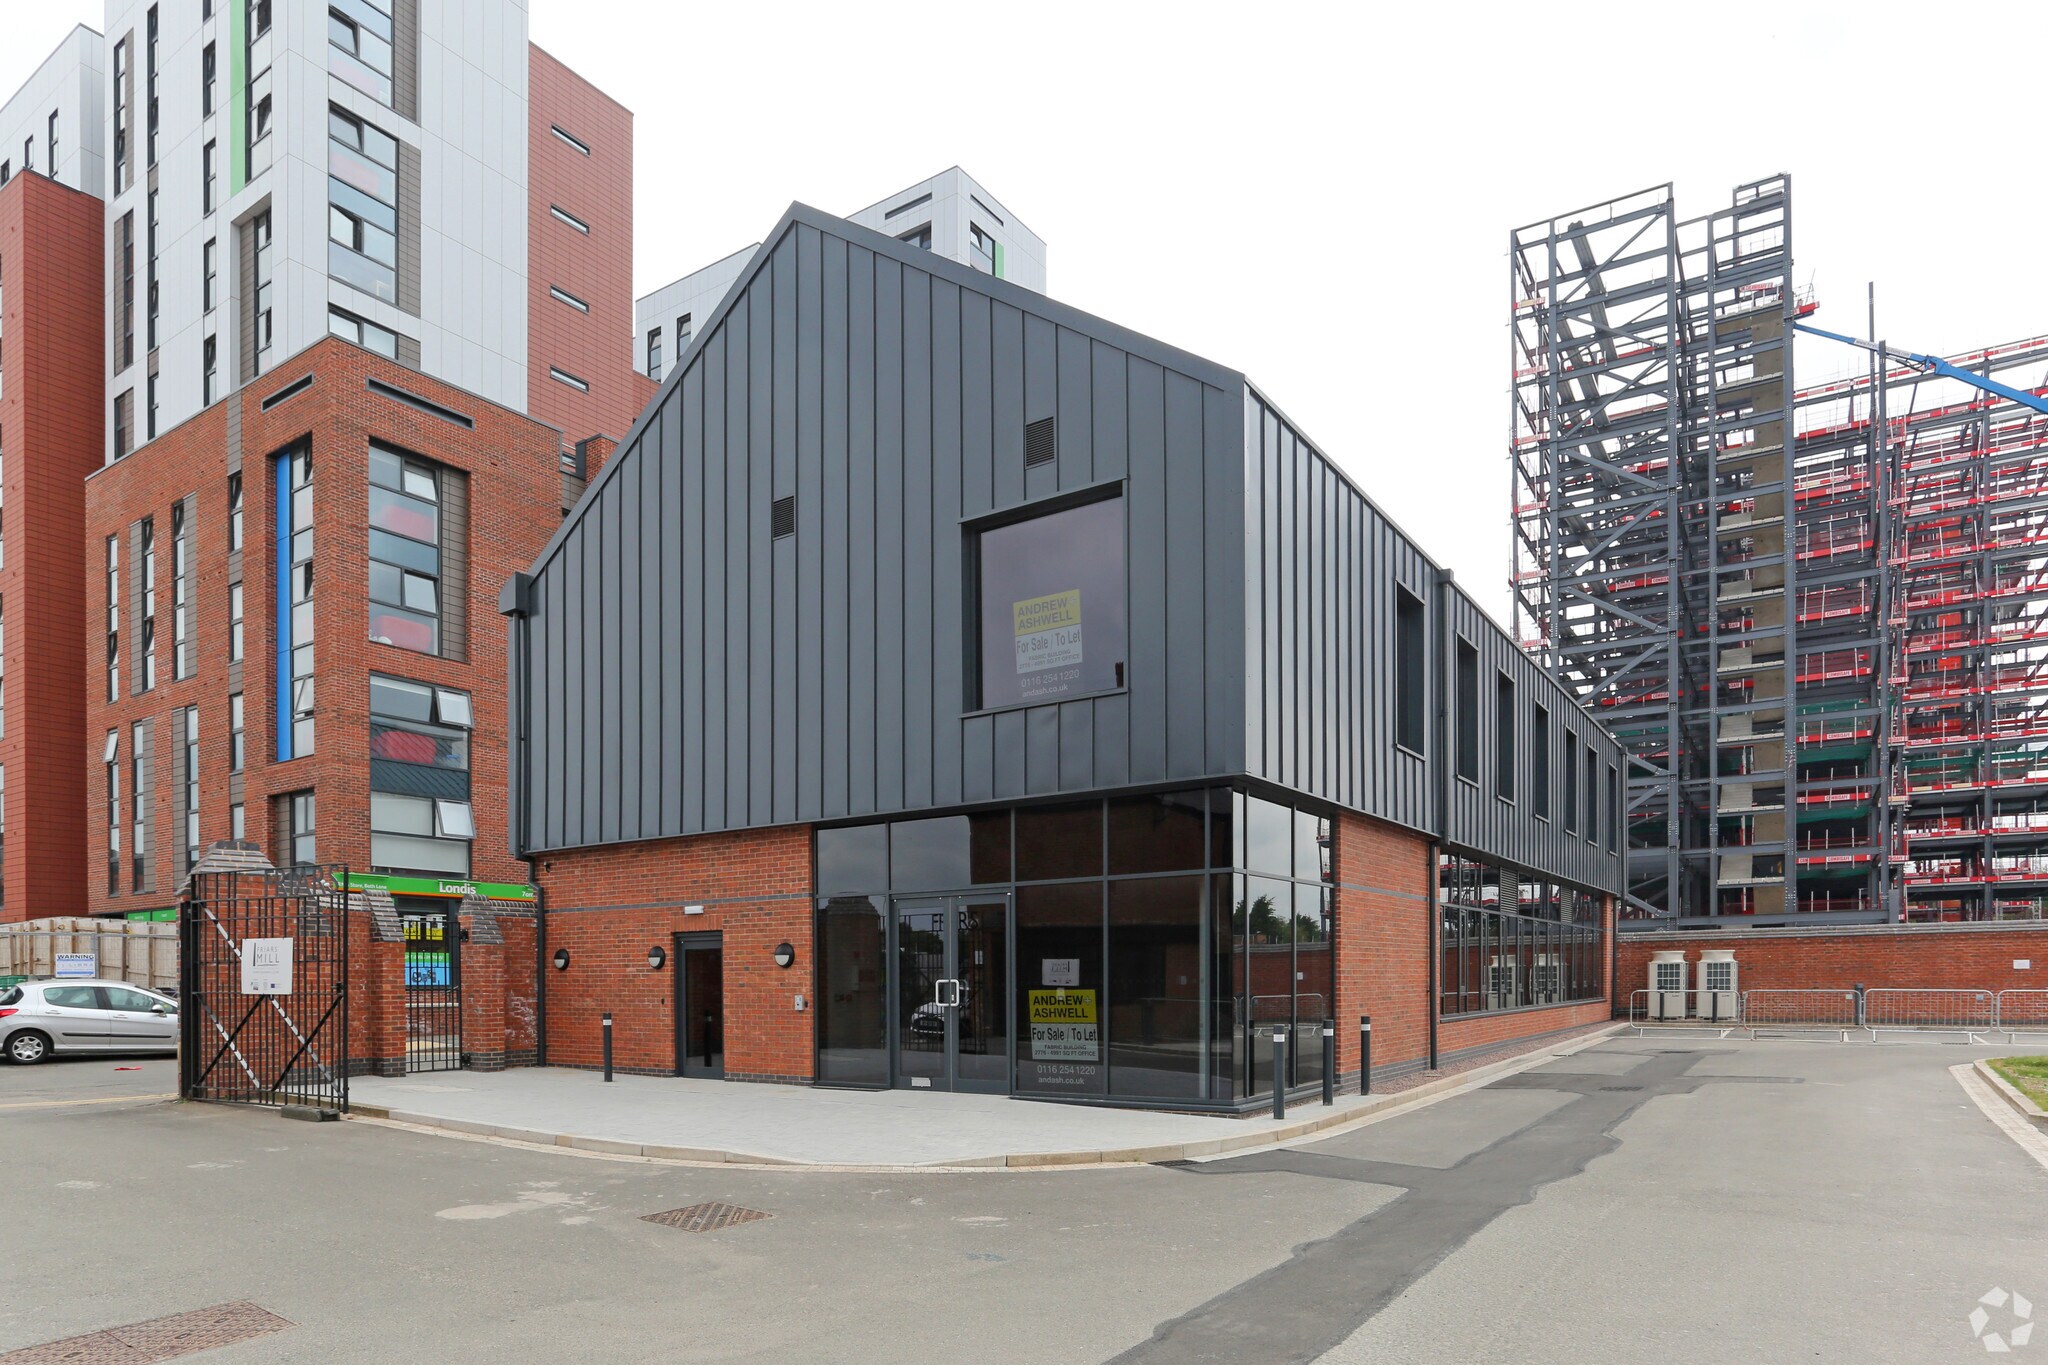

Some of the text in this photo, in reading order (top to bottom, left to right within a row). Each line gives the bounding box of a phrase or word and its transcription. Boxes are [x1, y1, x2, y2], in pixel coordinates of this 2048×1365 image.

[1018, 597, 1068, 618] ANDREW
[1018, 610, 1073, 630] ASHWELL
[1016, 640, 1029, 654] For
[1031, 636, 1048, 651] Sale
[1055, 632, 1065, 646] To
[1067, 629, 1080, 644] Let
[1047, 649, 1071, 658] BUILDING
[1061, 653, 1080, 661] OFFICE
[1021, 669, 1080, 687] 0116 254 1220
[1022, 683, 1068, 697] andash.co.uk
[439, 881, 477, 894] Londis
[256, 953, 280, 963] MILL
[1033, 995, 1083, 1005] ANDREW
[1034, 1008, 1088, 1018] ASHWELL
[1032, 1028, 1045, 1040] For
[1047, 1027, 1065, 1040] Sale
[1071, 1028, 1082, 1041] To
[1084, 1028, 1096, 1041] Let
[1037, 1065, 1096, 1075] 0116 254 1220
